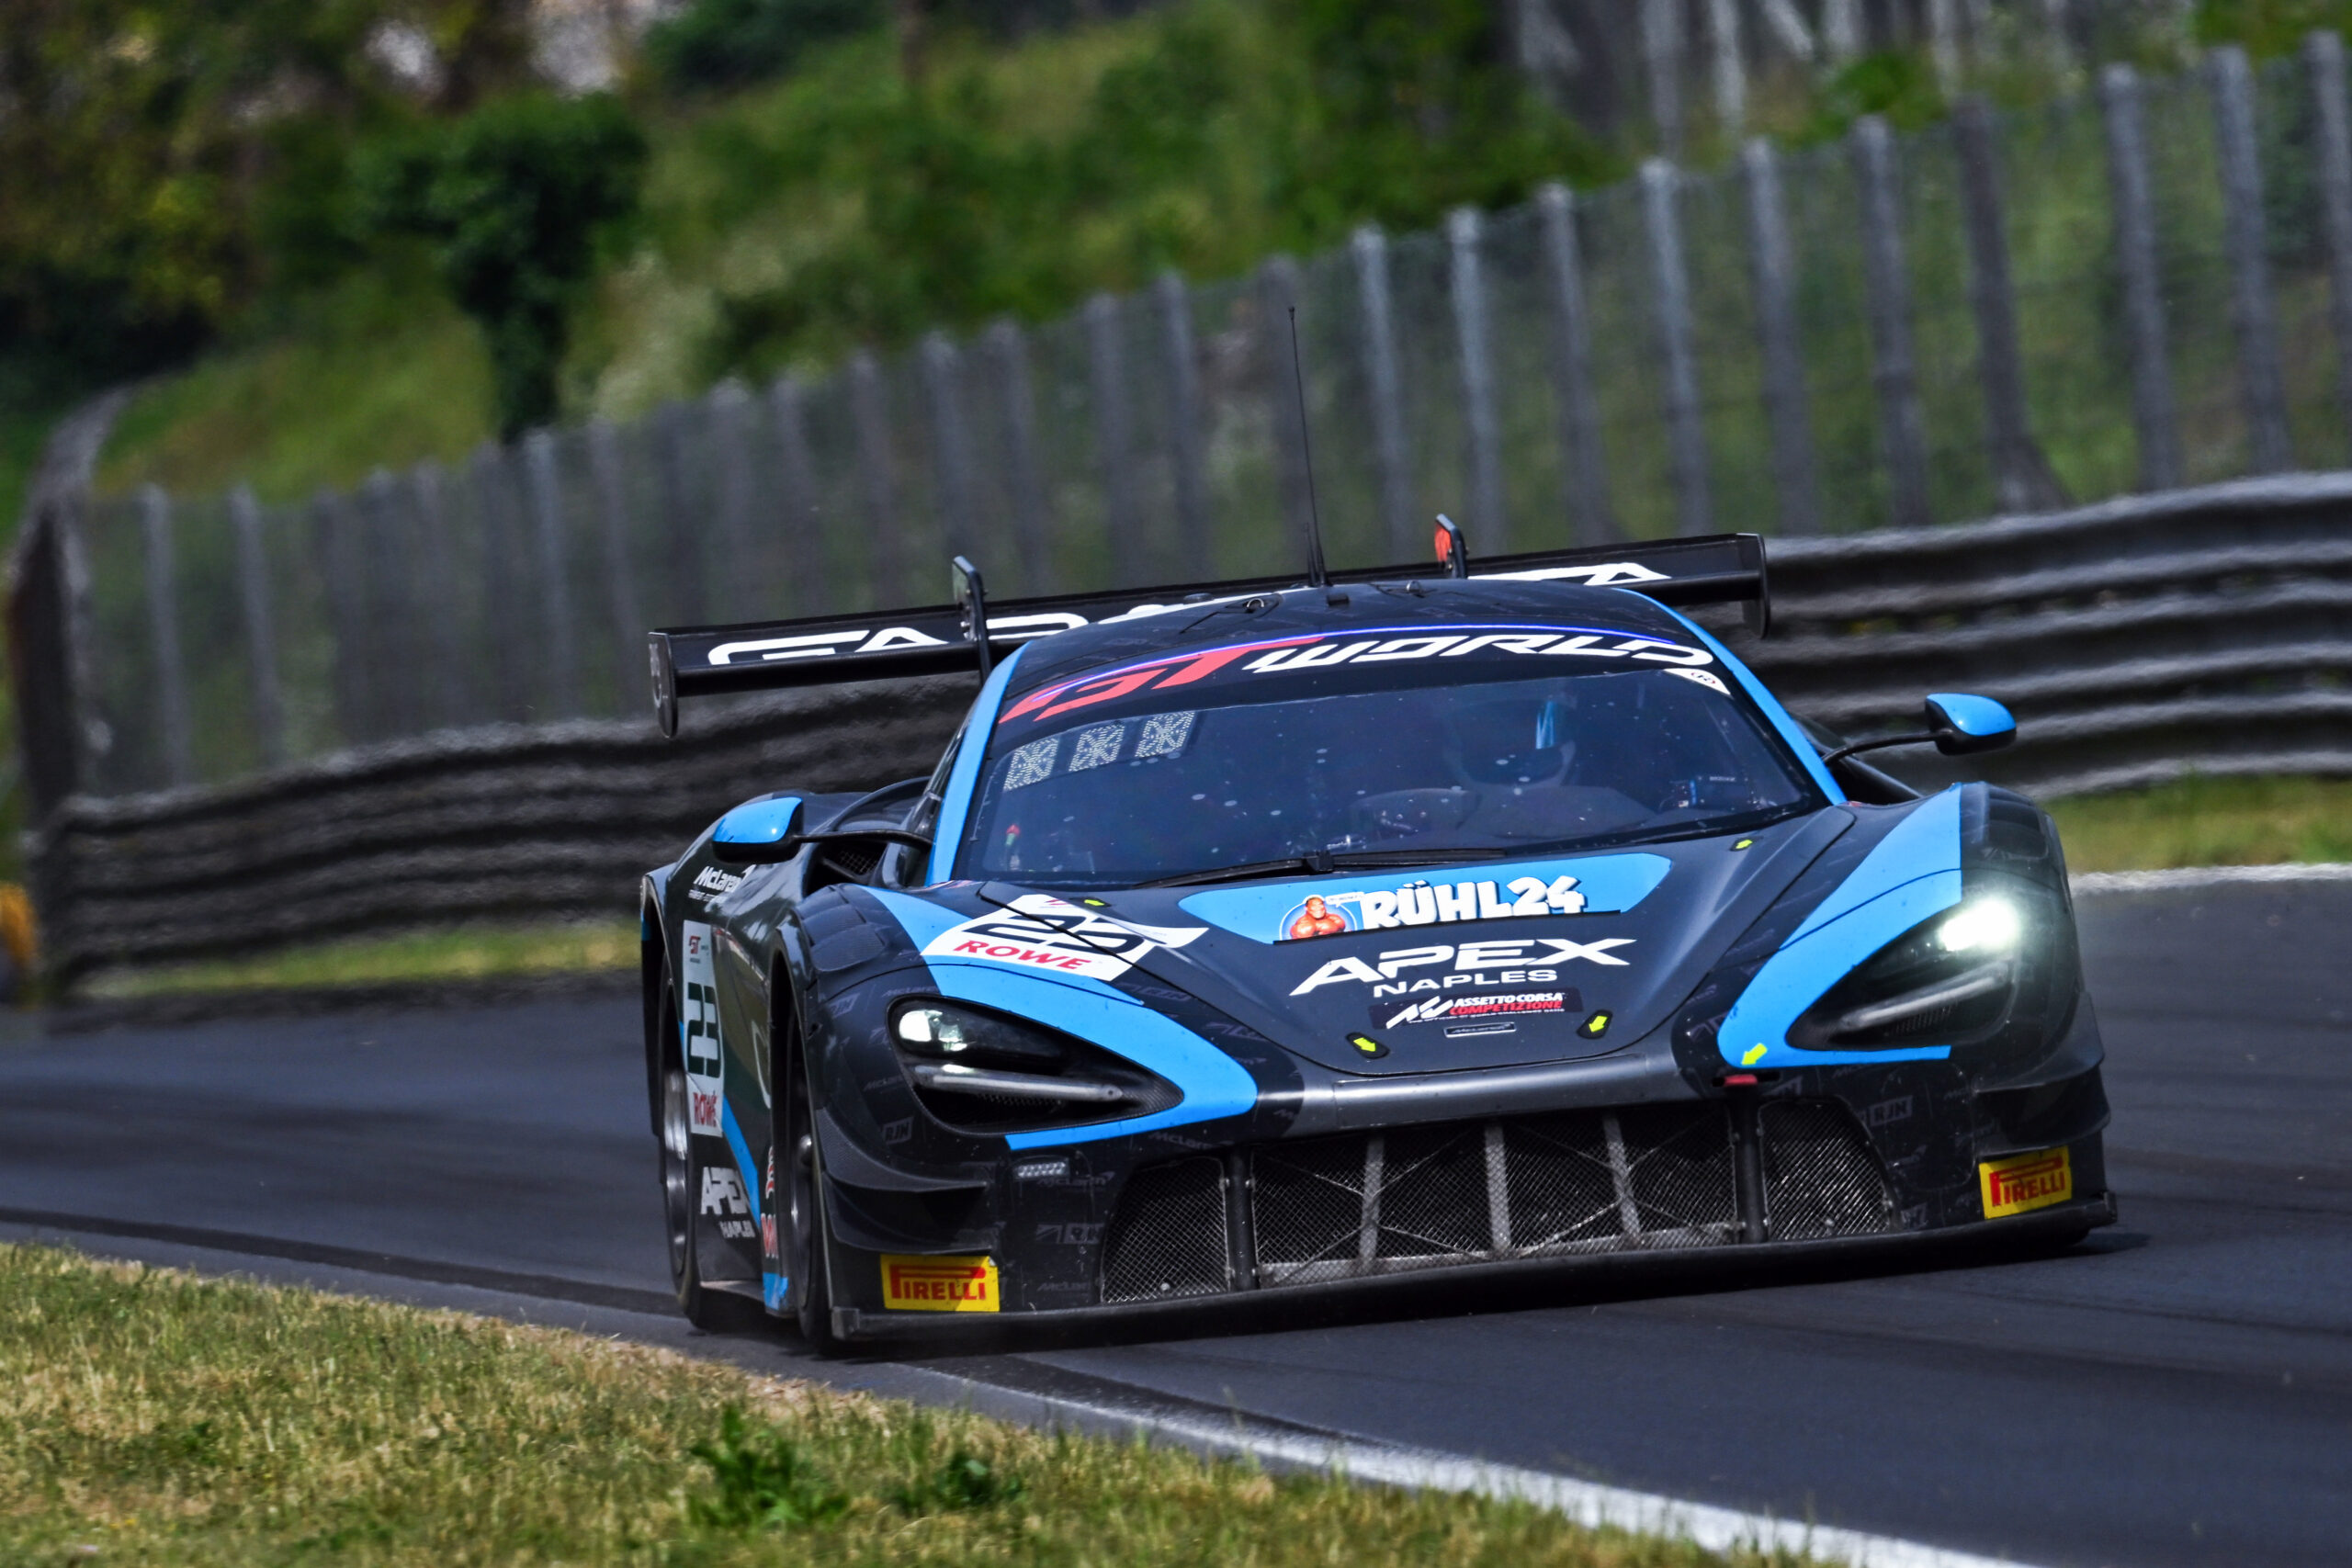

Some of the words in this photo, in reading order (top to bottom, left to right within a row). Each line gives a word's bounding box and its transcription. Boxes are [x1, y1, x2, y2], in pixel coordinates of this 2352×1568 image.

[1241, 634, 1715, 675] WORLD
[1360, 875, 1588, 930] RÜHL24
[953, 939, 1092, 970] ROWE
[1288, 937, 1638, 997] APEX
[1373, 969, 1558, 998] NAPLES
[1453, 994, 1516, 1008] ASSETTO
[1516, 992, 1564, 1003] CORSA
[1449, 999, 1563, 1016] COMPETIZIONE
[687, 981, 721, 1078] 23
[1988, 1156, 2065, 1207] PIRELLI
[889, 1264, 987, 1301] PIRELLI
